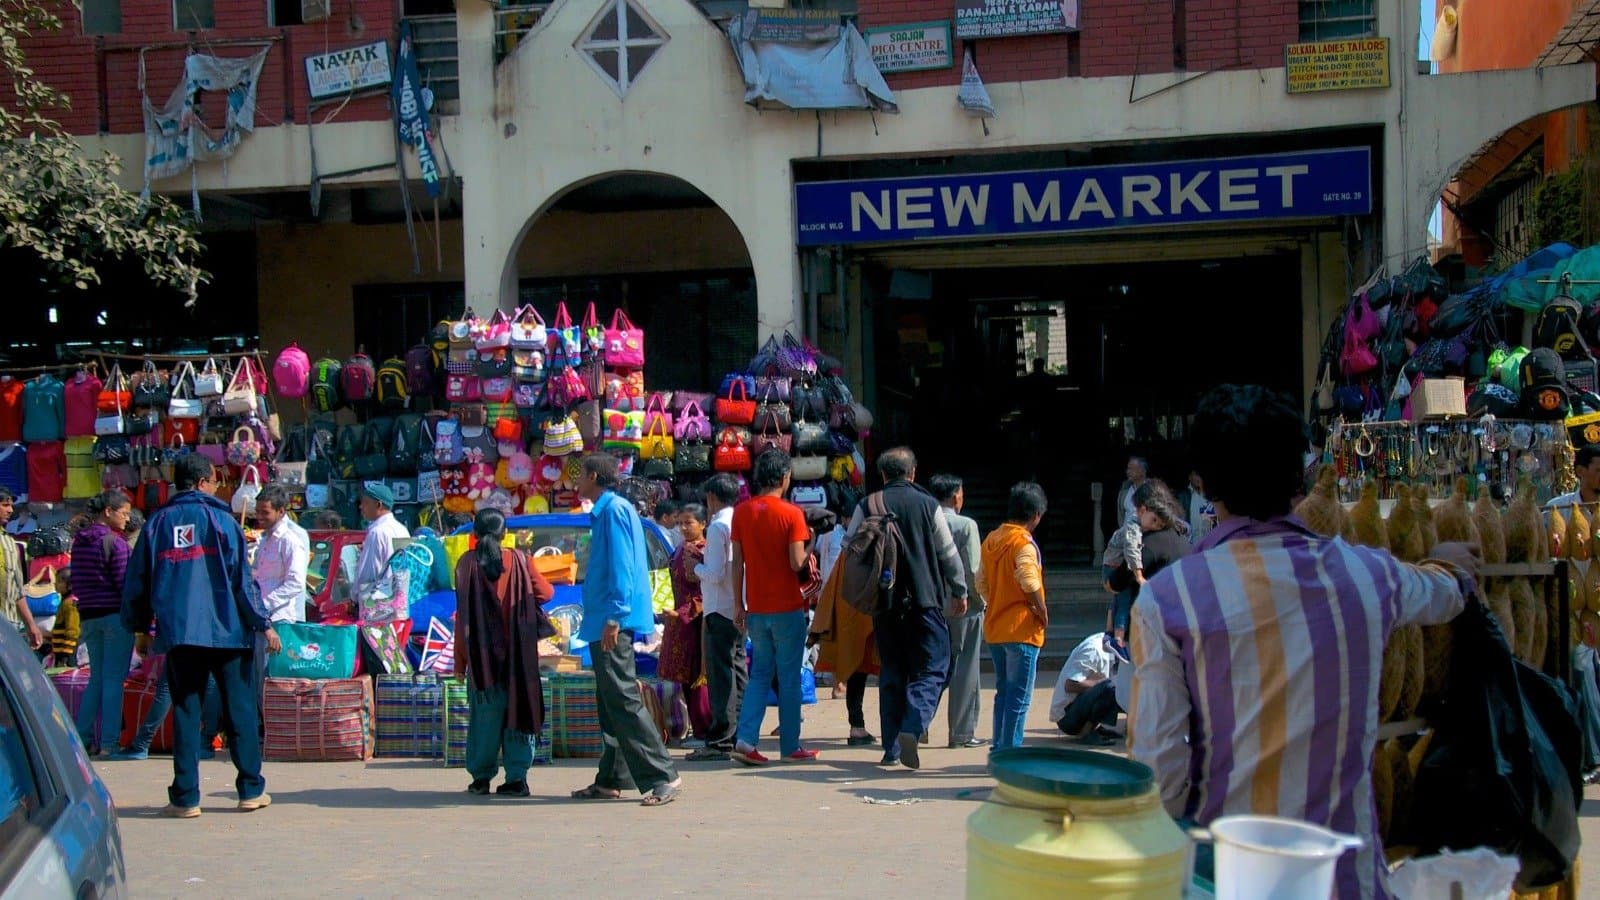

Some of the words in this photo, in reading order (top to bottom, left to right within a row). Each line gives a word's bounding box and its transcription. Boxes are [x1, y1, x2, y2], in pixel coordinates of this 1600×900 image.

[957, 6, 1006, 18] RANJAN
[1018, 1, 1058, 13] KARAN
[890, 29, 925, 42] SAAJAN
[871, 44, 896, 56] PICO
[900, 40, 944, 53] CENTRE
[1288, 43, 1316, 56] KOLKATA
[1319, 41, 1344, 54] LADIES
[1347, 40, 1385, 52] TAILORS
[312, 45, 378, 72] NAYAK
[851, 184, 990, 232] NEW
[1012, 164, 1309, 224] MARKET
[800, 223, 826, 232] BLOCK
